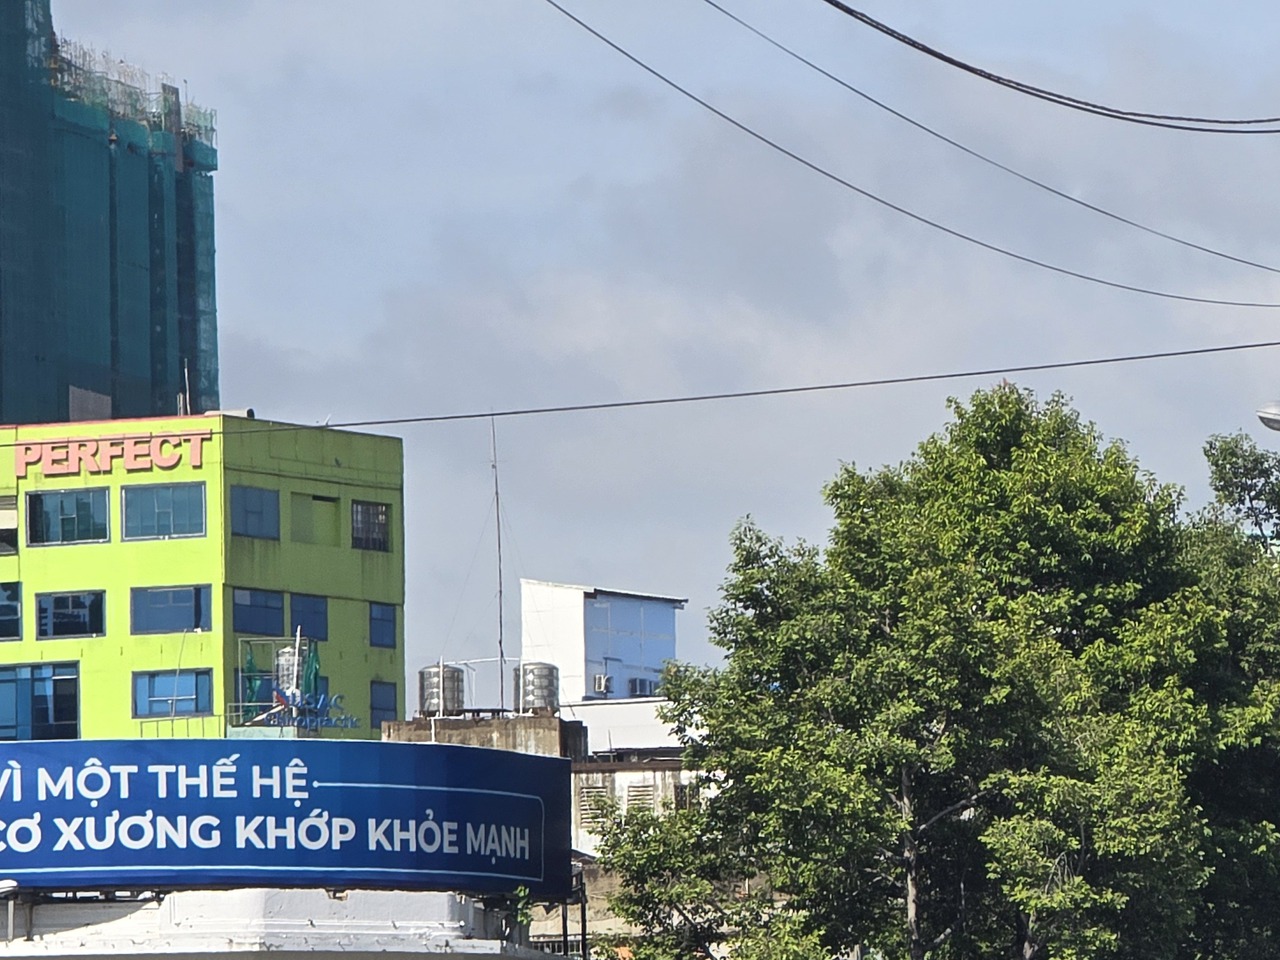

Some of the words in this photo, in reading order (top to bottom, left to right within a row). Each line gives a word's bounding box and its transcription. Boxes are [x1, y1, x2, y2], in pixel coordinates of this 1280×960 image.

[15, 428, 212, 478] PERFECT
[38, 757, 138, 808] MỘT
[147, 754, 240, 799] THẾ
[252, 758, 309, 808] HỆ
[53, 810, 221, 852] XƯƠNG
[235, 808, 356, 851] KHỚP
[368, 809, 459, 854] KHỎE
[466, 822, 530, 865] MẠNH
